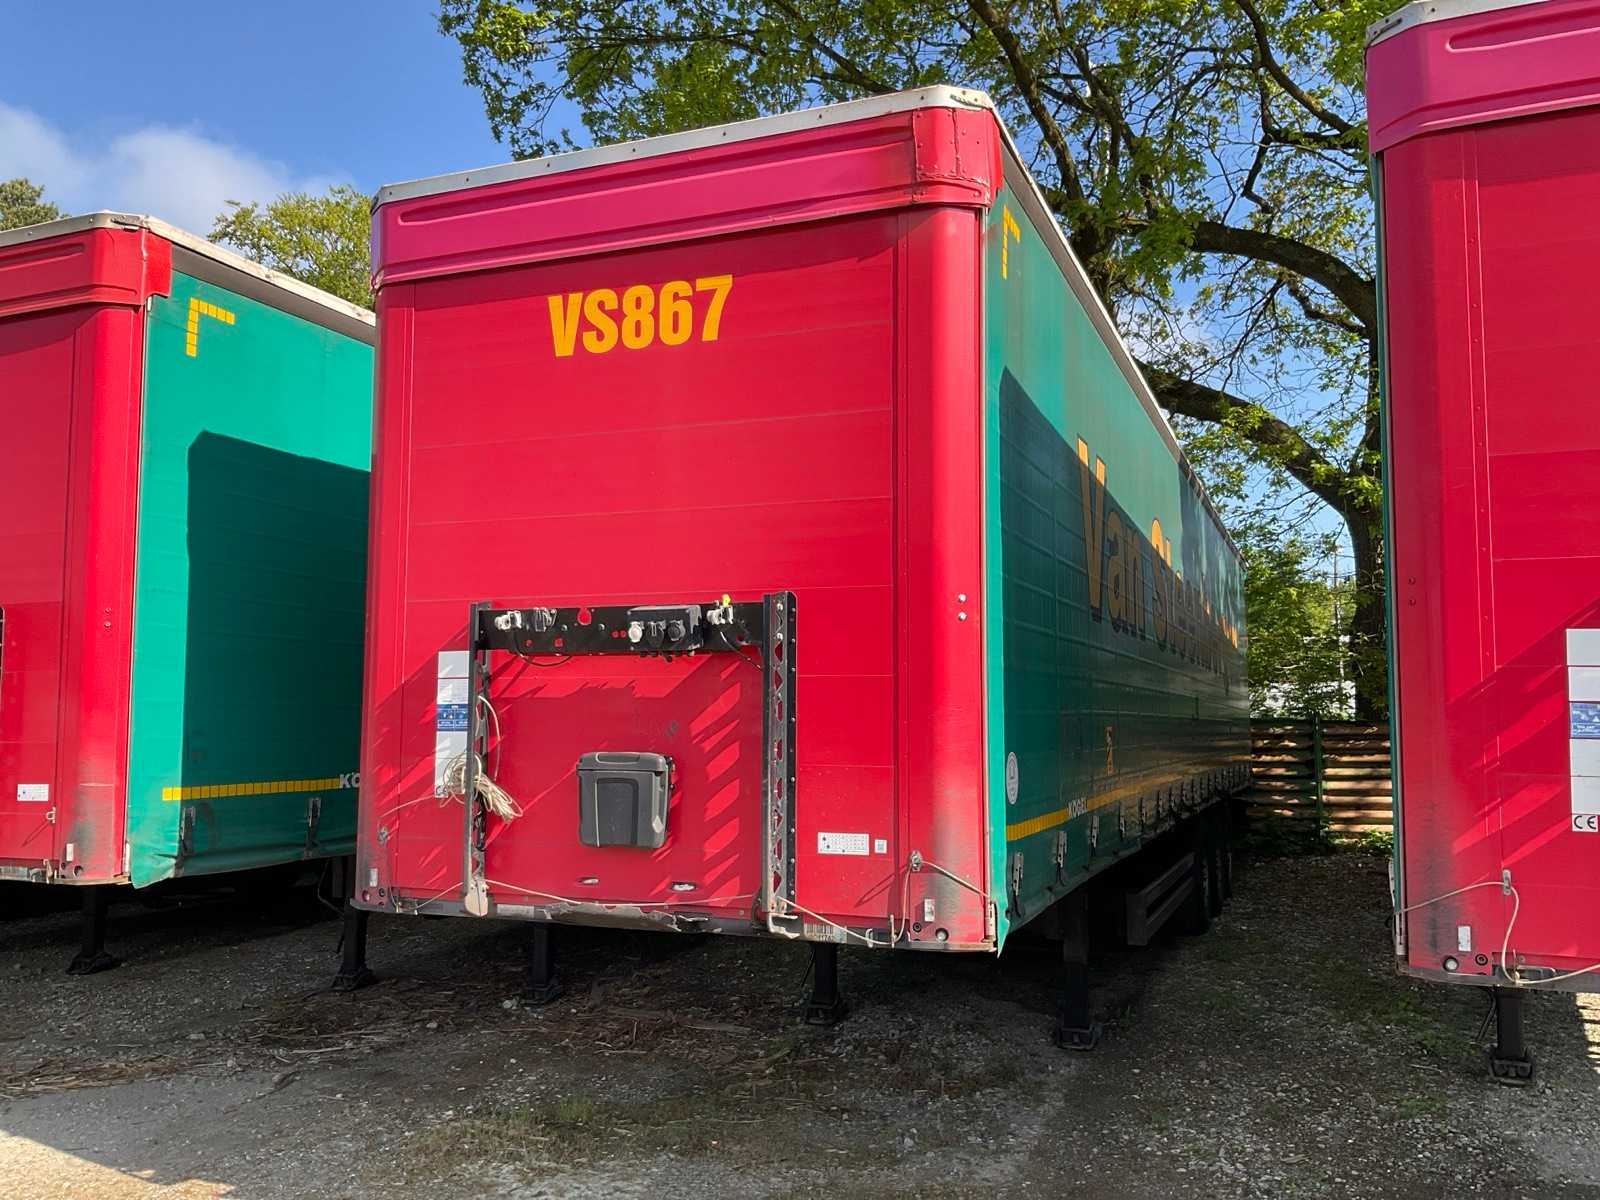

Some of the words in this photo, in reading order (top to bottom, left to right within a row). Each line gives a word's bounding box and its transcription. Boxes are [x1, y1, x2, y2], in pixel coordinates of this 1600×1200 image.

[548, 274, 733, 357] VS867
[1076, 434, 1147, 640] Van
[1573, 815, 1597, 830] CE
